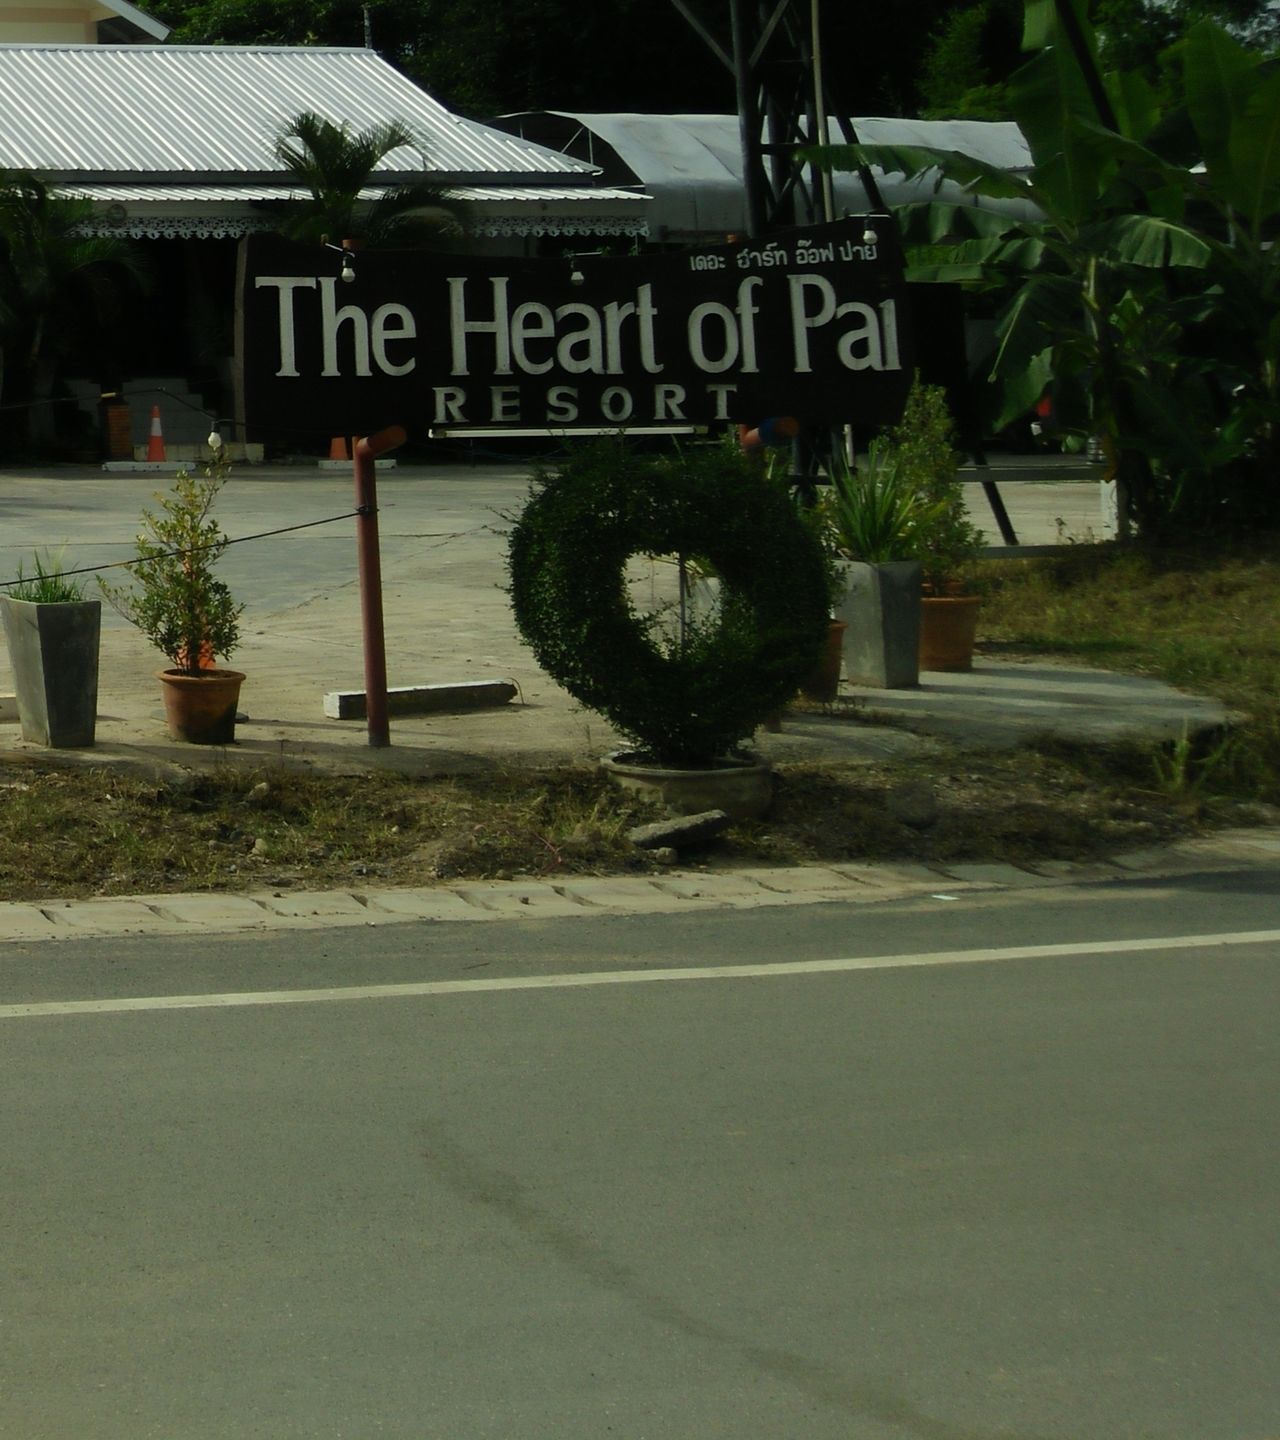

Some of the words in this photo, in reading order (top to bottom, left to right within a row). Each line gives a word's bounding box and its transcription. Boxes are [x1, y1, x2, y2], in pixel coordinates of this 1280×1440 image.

[690, 254, 726, 272] เดอะ
[736, 242, 788, 269] ฮาร์ท
[795, 239, 834, 265] อ๊อฟ
[839, 239, 878, 262] ปาย
[255, 276, 416, 376] The
[446, 276, 664, 375] Heart
[687, 275, 763, 373] of
[786, 273, 902, 373] Pai
[432, 383, 737, 423] RESORT
